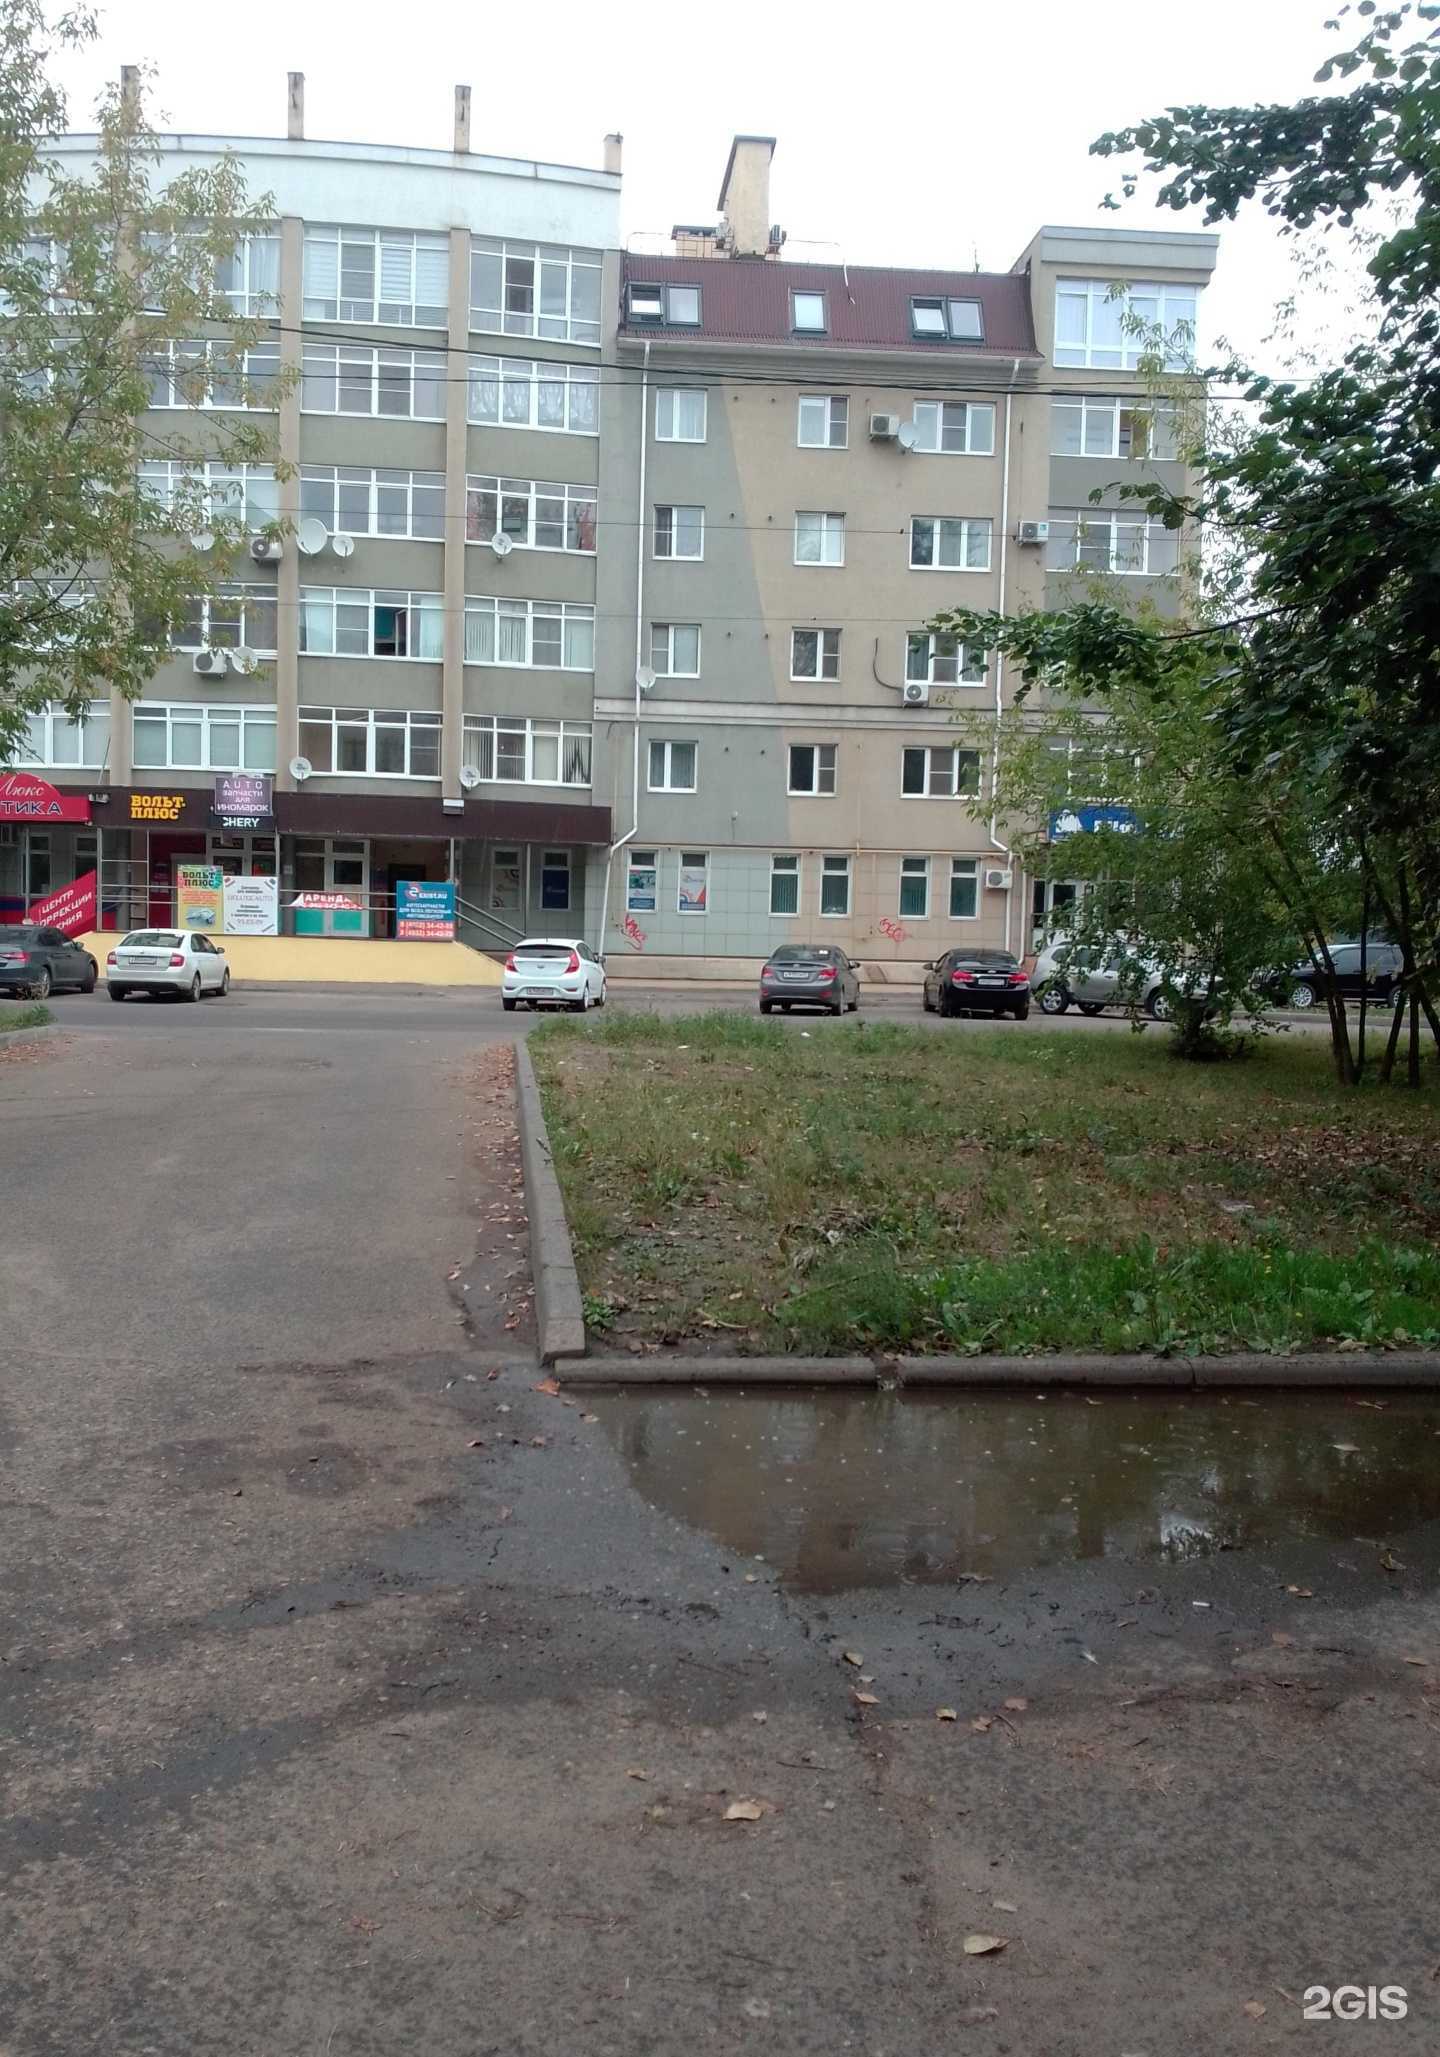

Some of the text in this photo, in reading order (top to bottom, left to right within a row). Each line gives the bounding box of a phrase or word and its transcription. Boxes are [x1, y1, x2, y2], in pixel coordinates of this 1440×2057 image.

[0, 775, 45, 796] Люкс
[223, 780, 263, 790] AUTO
[0, 800, 63, 815] ТИКА
[130, 794, 184, 808] ВОЛЬТ
[217, 803, 269, 813] иномарок
[130, 807, 179, 820] ПЛЮС
[41, 889, 74, 914] ЦЕНТР
[34, 891, 92, 928] ОРРЕКЦИИ
